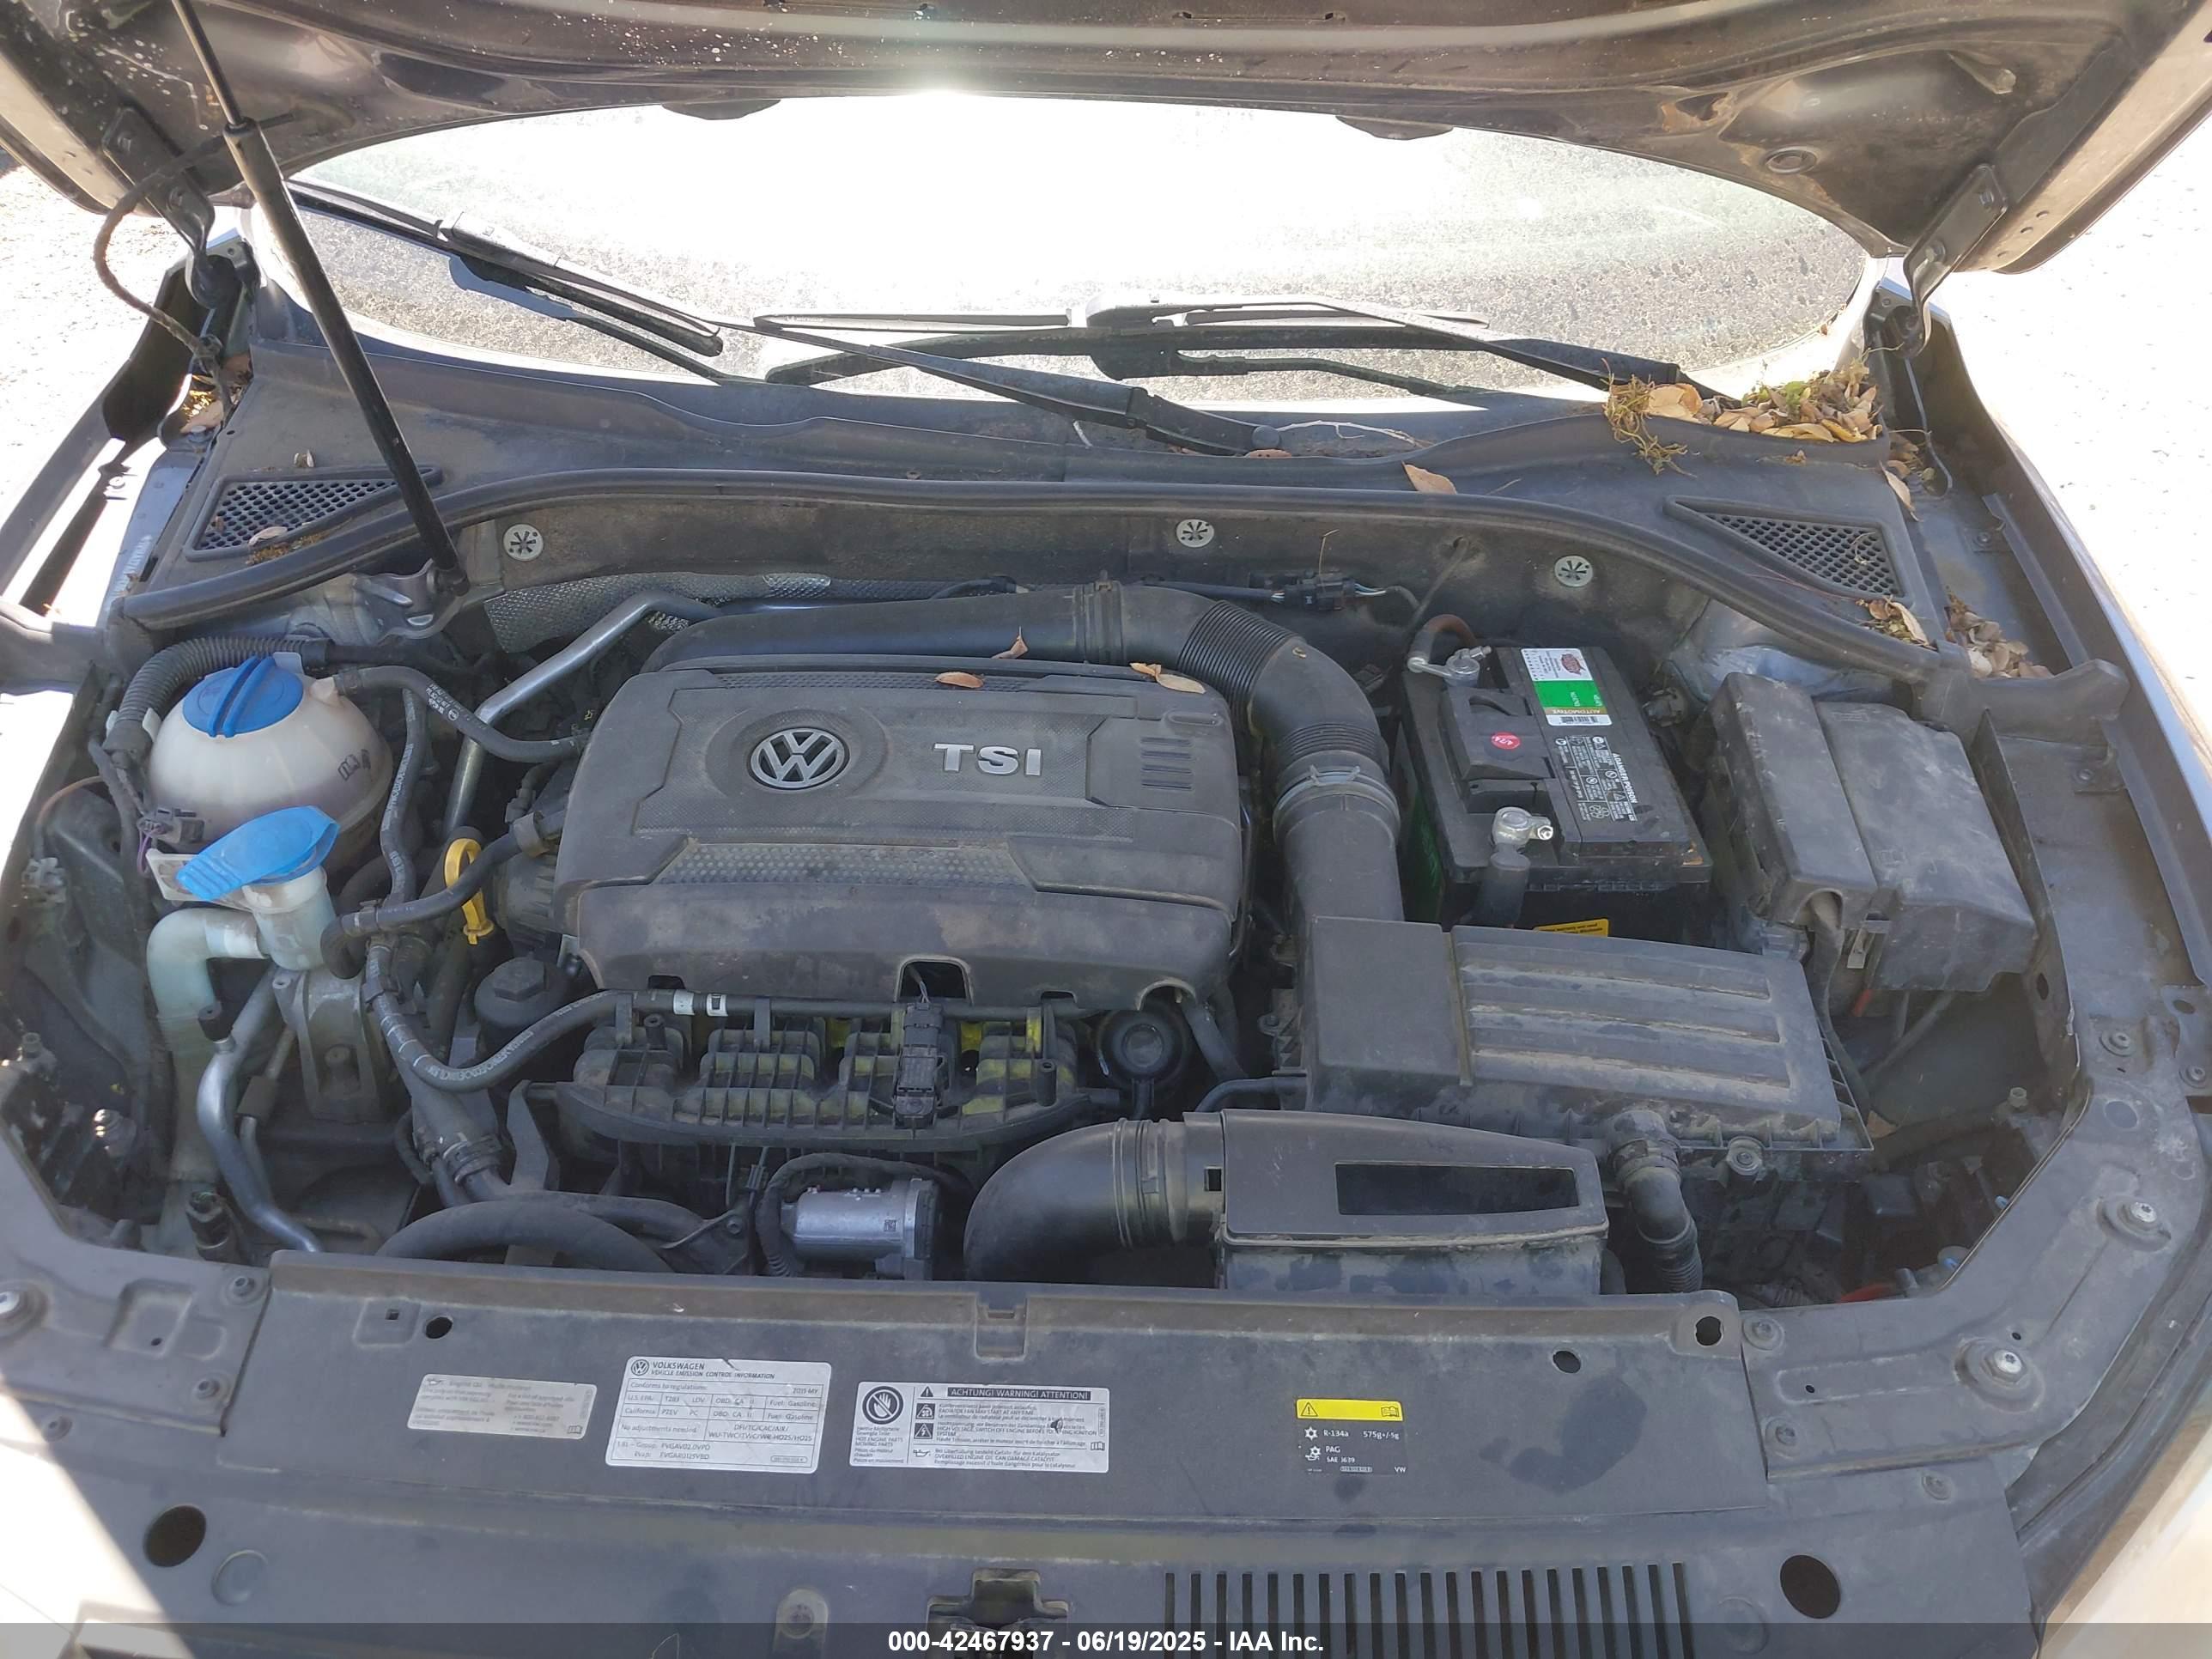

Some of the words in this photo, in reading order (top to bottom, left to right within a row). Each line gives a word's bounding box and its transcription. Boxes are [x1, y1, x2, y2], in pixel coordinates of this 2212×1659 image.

[933, 742, 1042, 776] TSI
[651, 1361, 705, 1370] VOLKSWAGEN
[1040, 1390, 1087, 1399] ATTENTION!
